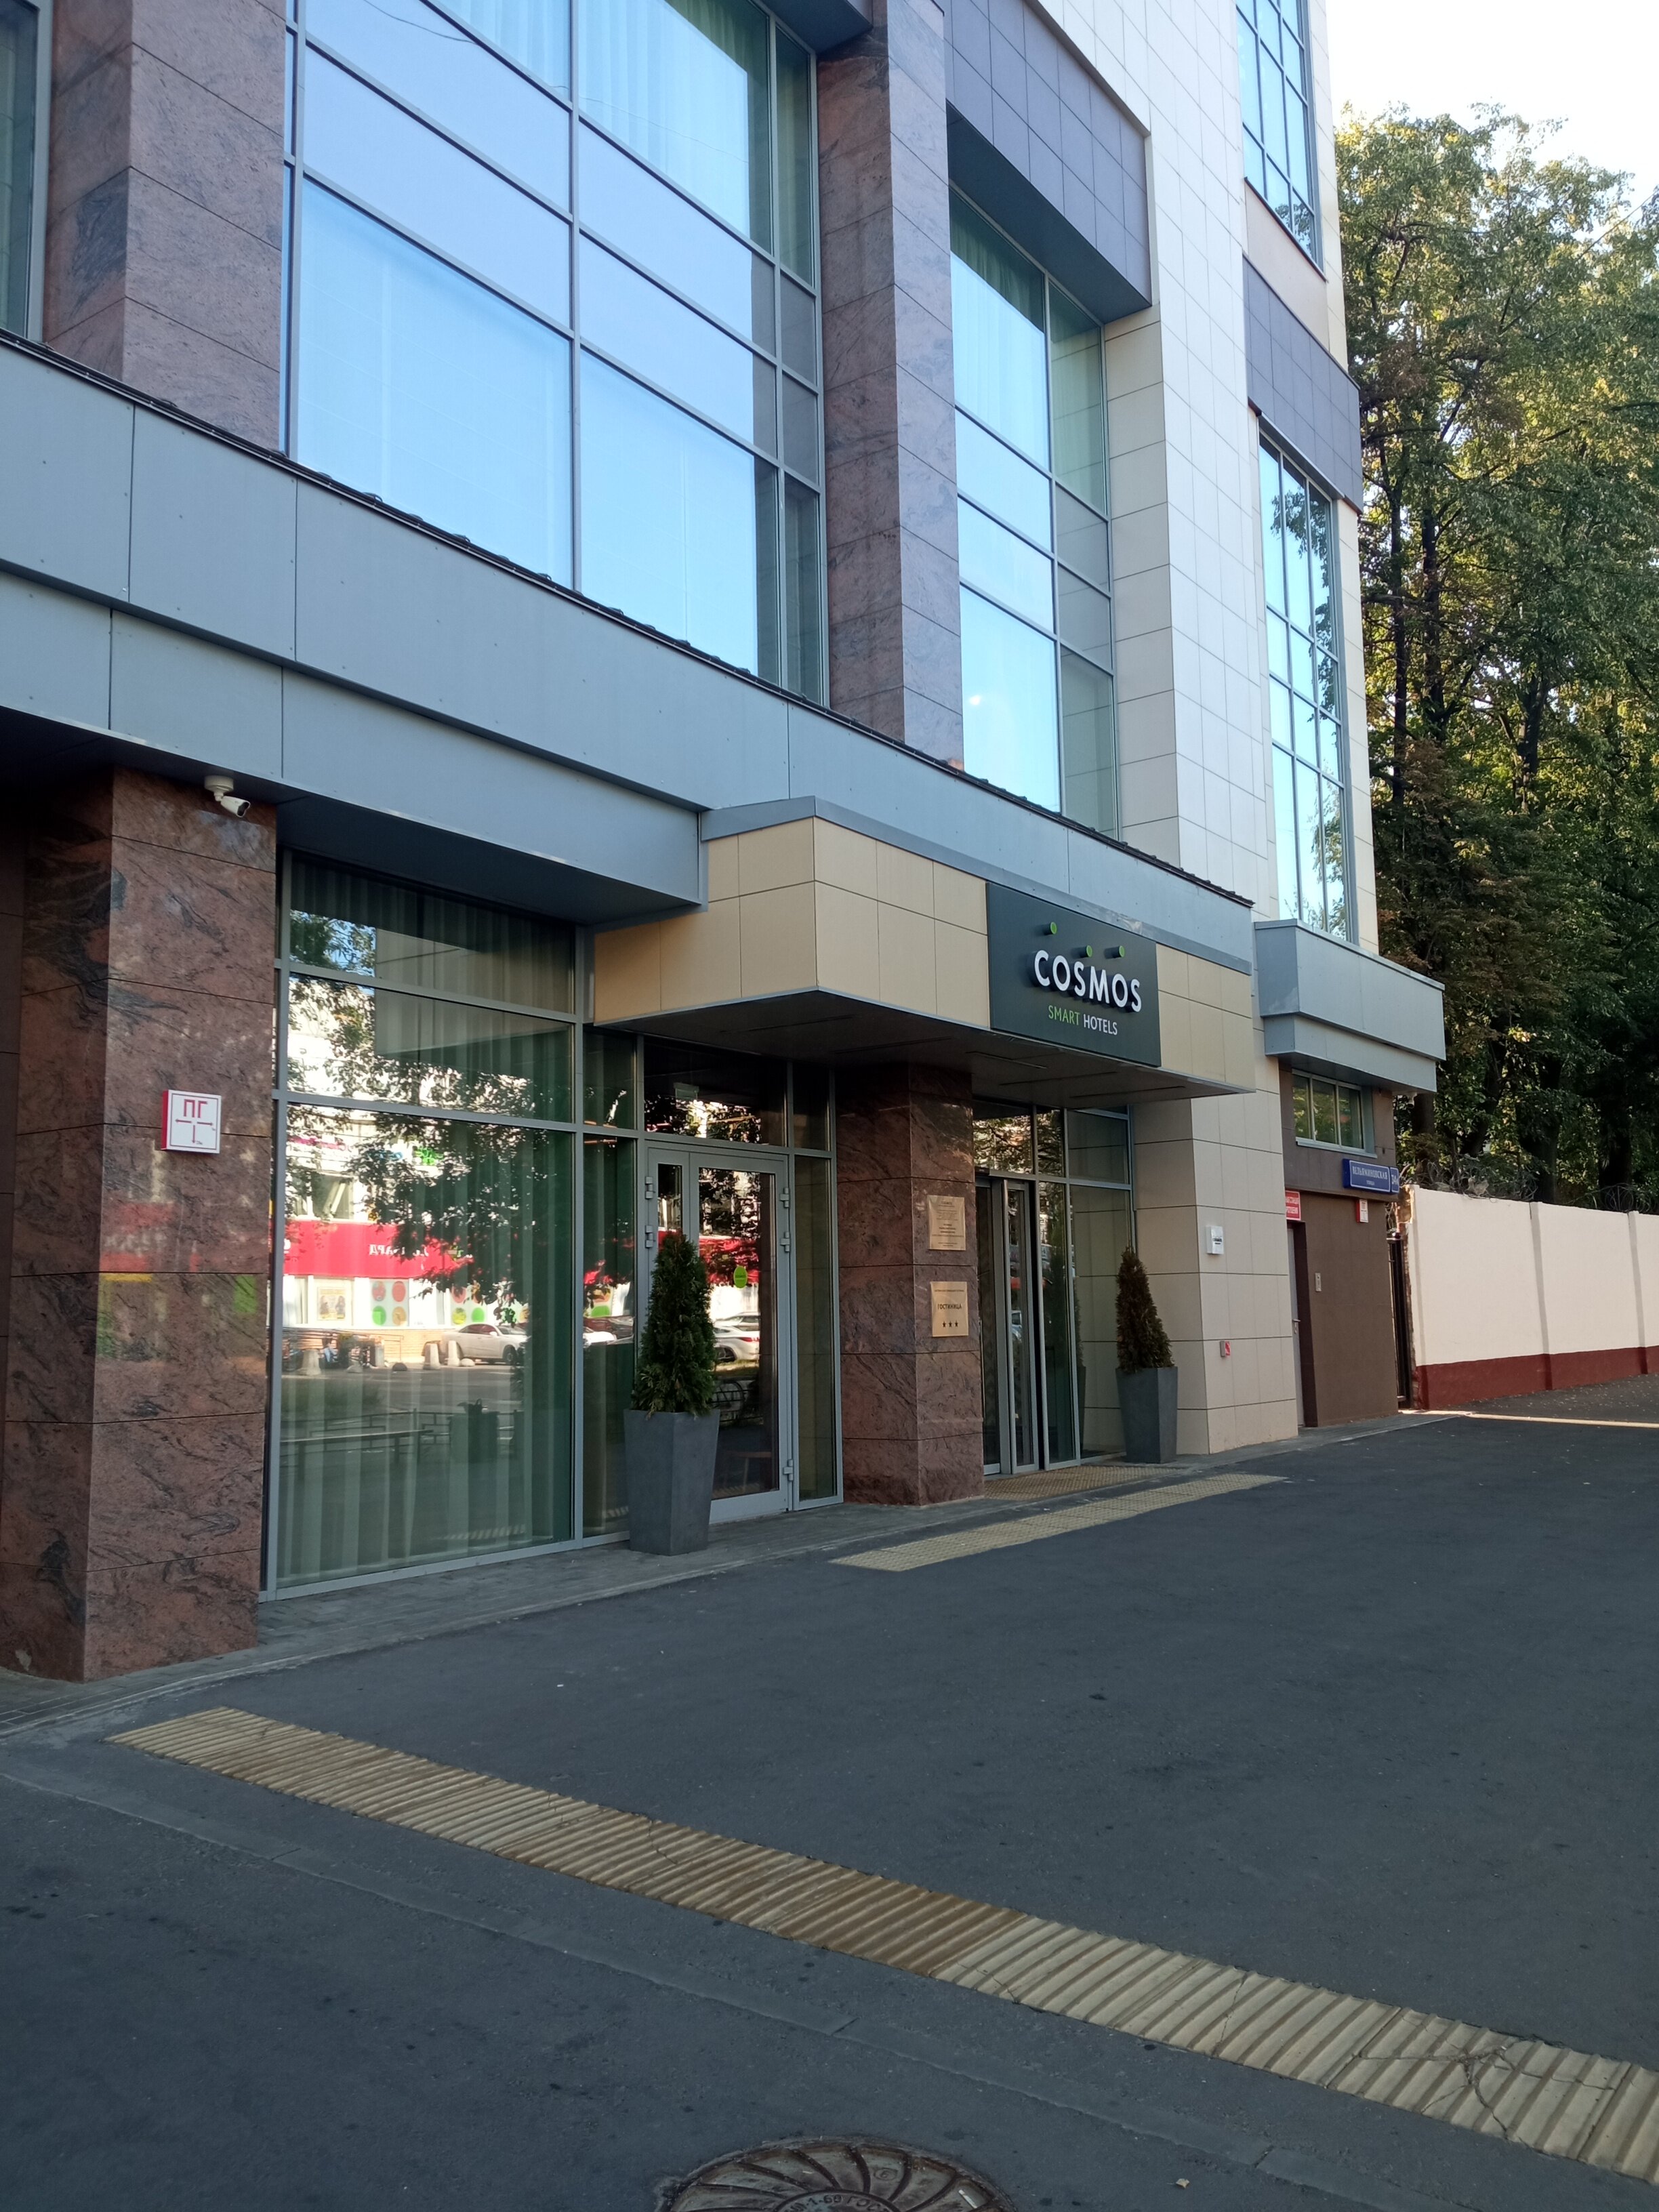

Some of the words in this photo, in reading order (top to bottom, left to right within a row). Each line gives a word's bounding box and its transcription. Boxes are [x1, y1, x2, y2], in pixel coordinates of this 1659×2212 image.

[1033, 949, 1142, 1012] COSMOS
[1048, 1004, 1080, 1026] SMART
[1083, 1013, 1118, 1036] HOTELS
[183, 1099, 208, 1118] ПГ
